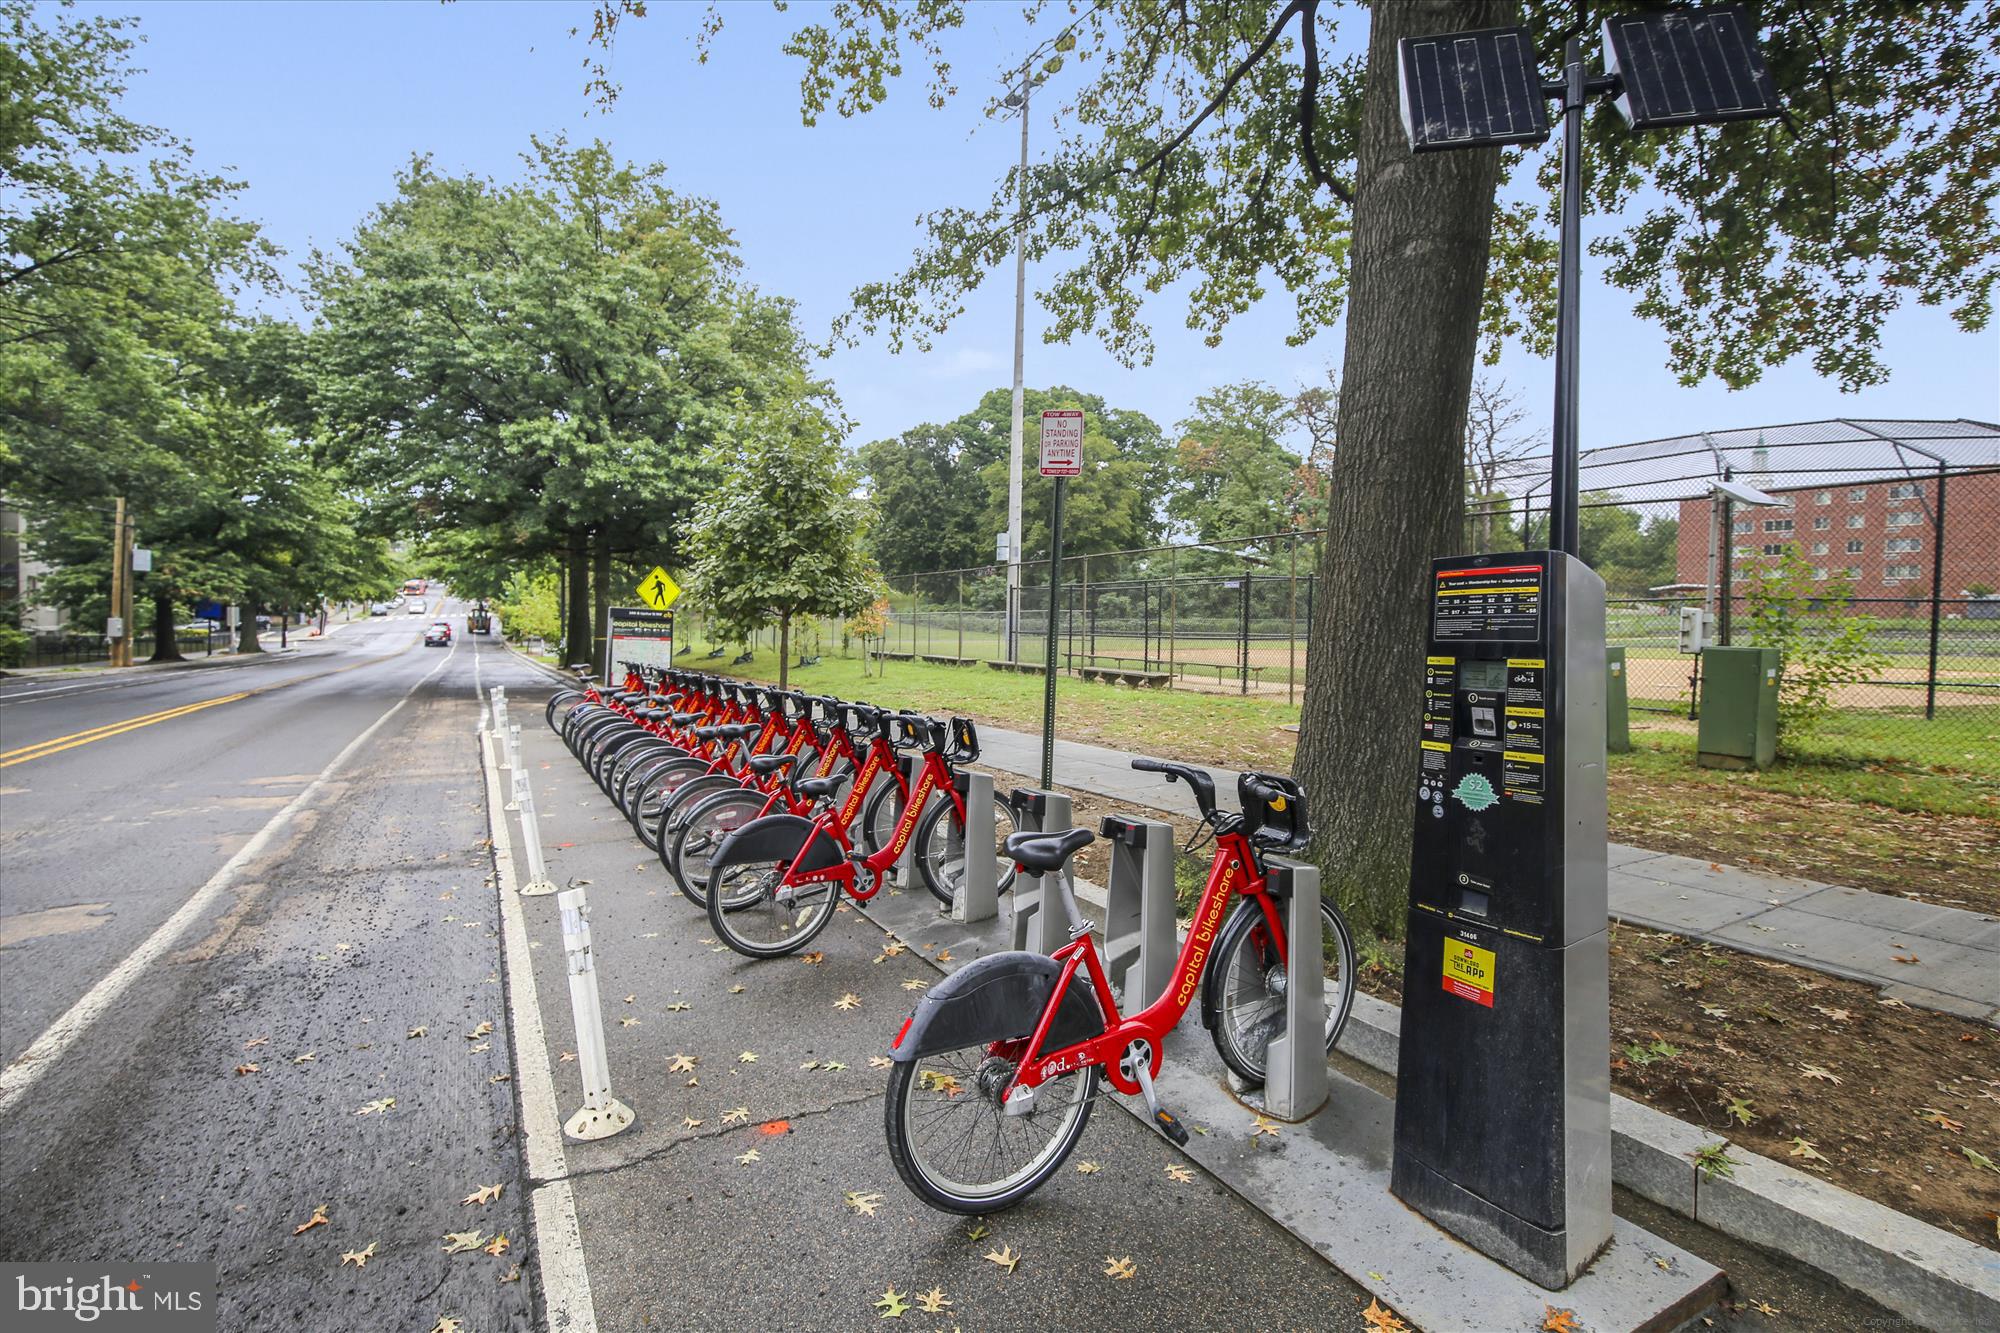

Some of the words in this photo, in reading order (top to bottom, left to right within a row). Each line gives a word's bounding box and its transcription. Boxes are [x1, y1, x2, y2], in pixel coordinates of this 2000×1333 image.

[1057, 420, 1068, 428] NO
[1045, 429, 1079, 438] STANDING
[1053, 439, 1079, 448] PARKING
[1047, 449, 1075, 458] ANYTIME
[841, 795, 859, 826] capital
[855, 755, 880, 794] bikeshare
[1468, 779, 1484, 791] $2
[893, 818, 913, 855] capital
[906, 773, 934, 818] bikeshare
[1177, 945, 1205, 1007] capital
[1195, 868, 1234, 943] bikeshare
[1466, 965, 1485, 979] APP
